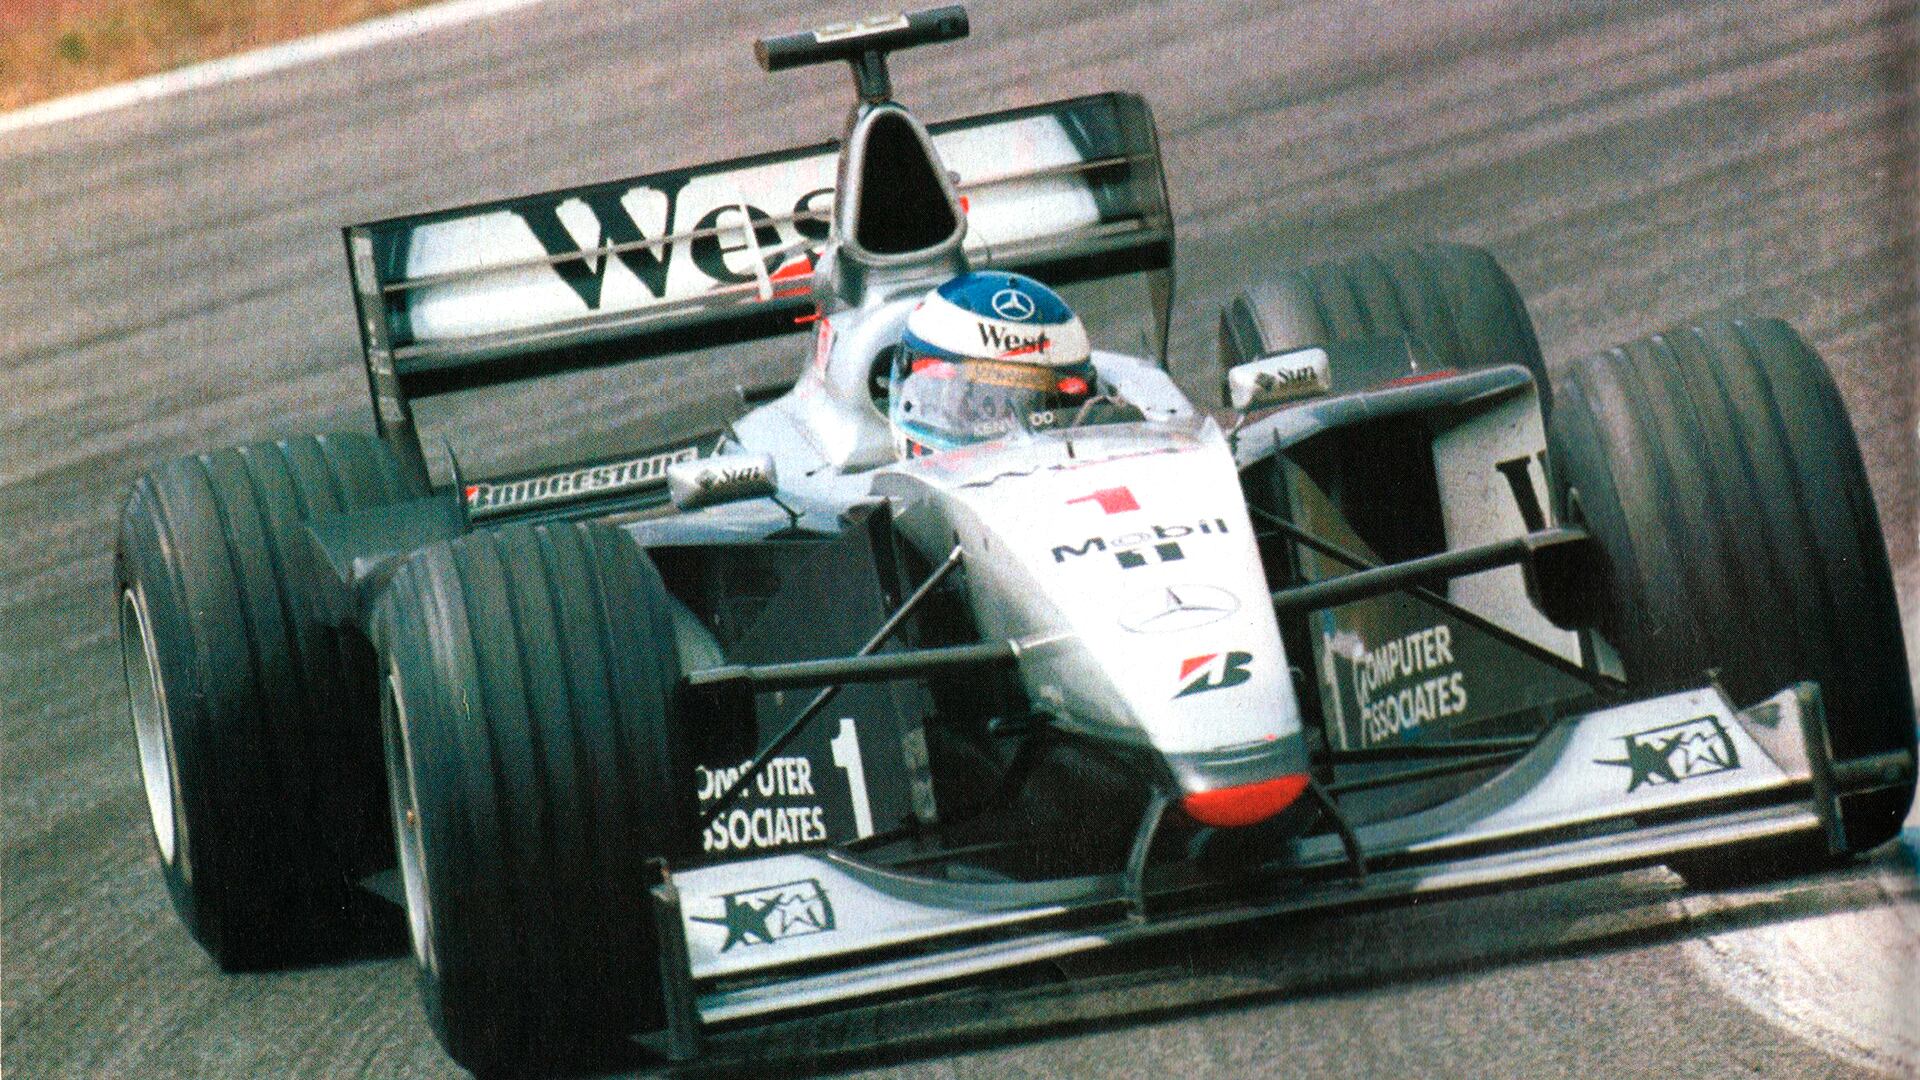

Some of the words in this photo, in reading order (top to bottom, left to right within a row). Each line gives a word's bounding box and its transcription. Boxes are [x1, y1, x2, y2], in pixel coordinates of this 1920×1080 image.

[512, 170, 836, 310] Wes
[978, 322, 1048, 354] West
[1051, 518, 1229, 563] Mobil
[831, 717, 875, 839] 1
